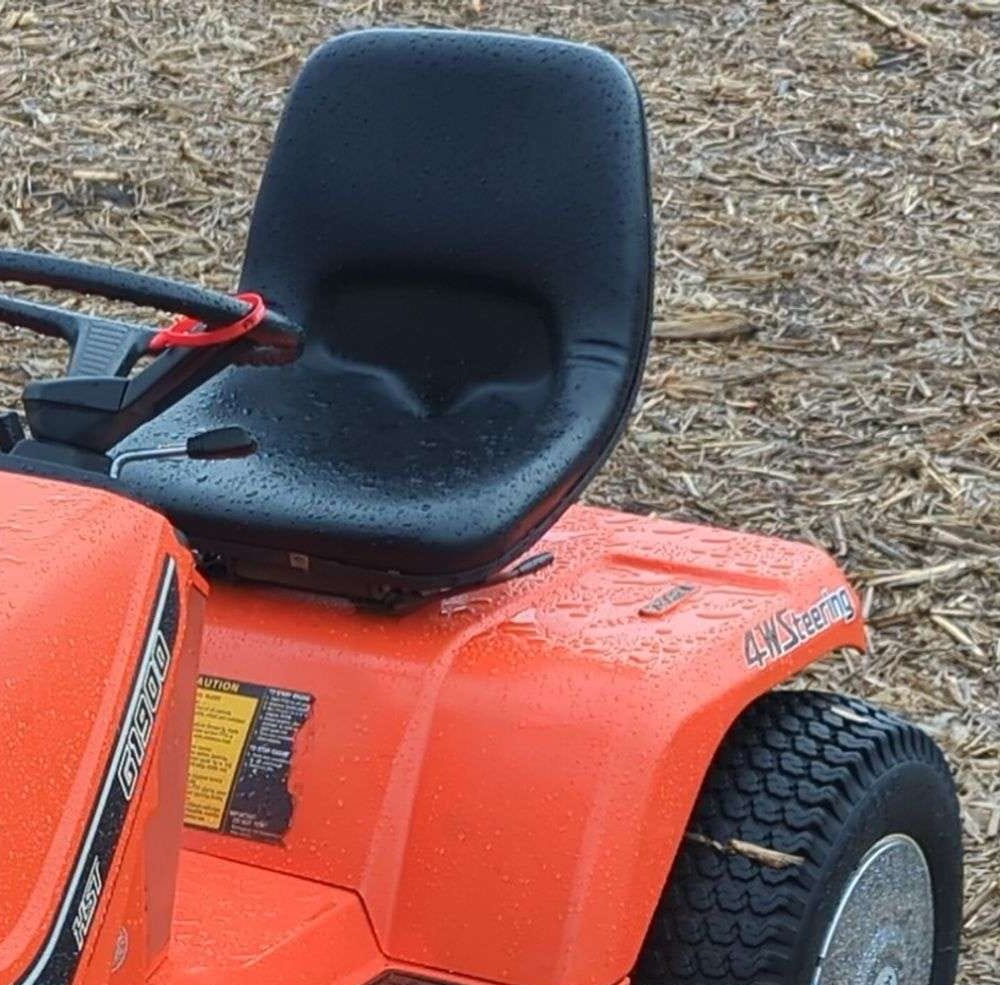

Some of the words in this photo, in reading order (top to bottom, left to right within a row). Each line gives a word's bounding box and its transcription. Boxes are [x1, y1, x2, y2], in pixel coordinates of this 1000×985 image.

[118, 629, 171, 801] G1900
[196, 676, 240, 692] AUTION
[72, 855, 102, 951] HST
